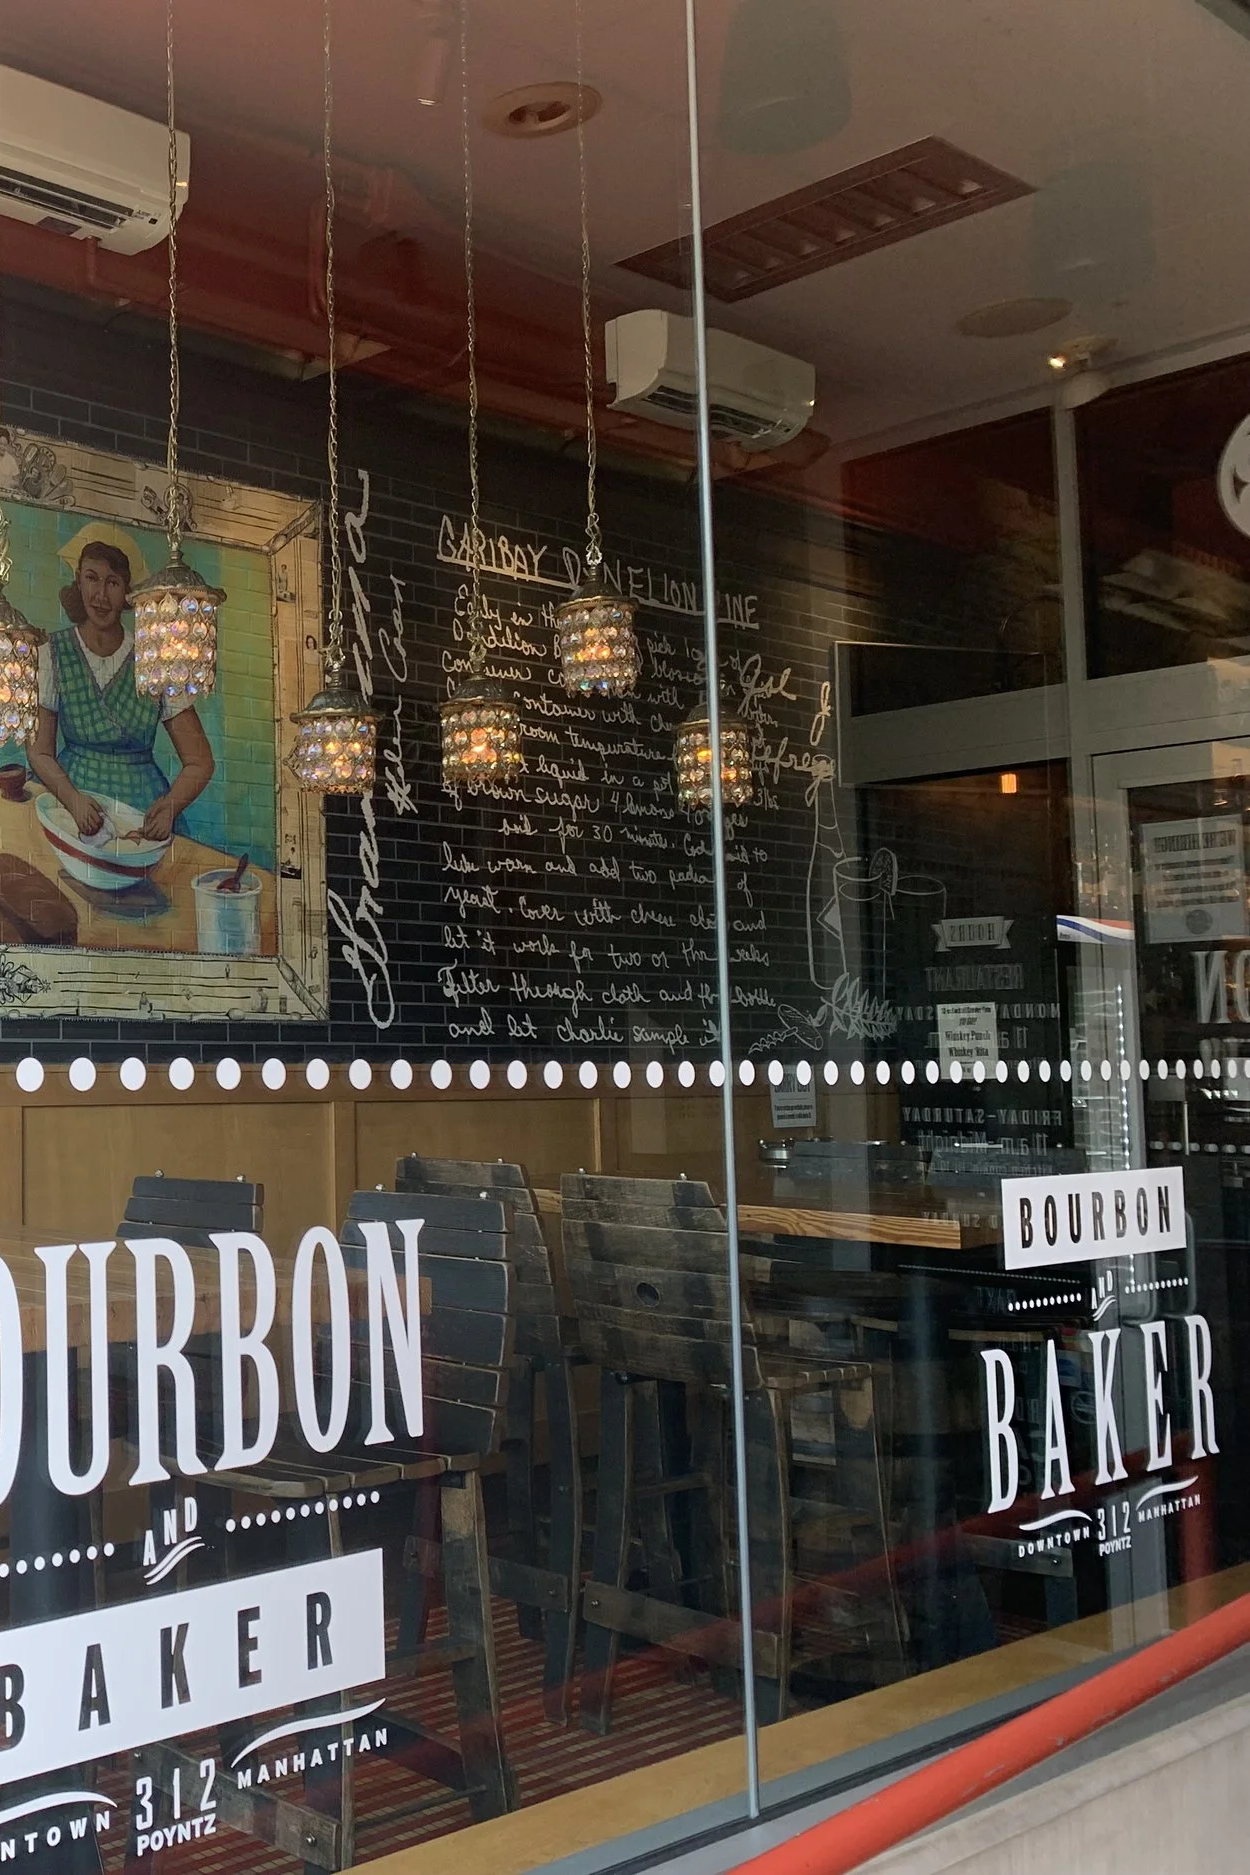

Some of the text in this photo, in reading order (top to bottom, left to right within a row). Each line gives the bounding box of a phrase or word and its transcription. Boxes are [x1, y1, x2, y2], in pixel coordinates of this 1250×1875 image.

[436, 513, 548, 581] GARIBAY
[535, 786, 600, 823] sugar
[549, 816, 584, 854] for
[592, 825, 612, 843] 30
[546, 855, 577, 877] and
[590, 855, 621, 883] add
[733, 910, 767, 932] and
[444, 925, 470, 949] let
[607, 943, 642, 970] two
[602, 983, 651, 1005] cloth
[658, 980, 693, 1001] and
[448, 1006, 496, 1039] and
[507, 1013, 538, 1039] let
[632, 1023, 690, 1055] sample
[1019, 1185, 1172, 1249] BOURBON
[1091, 1270, 1114, 1310] AND
[980, 1314, 1220, 1514] BAKER
[1137, 1494, 1201, 1523] MANHATTAN
[142, 1497, 199, 1566] AND
[1018, 1526, 1090, 1558] DOWNTOWN
[1099, 1536, 1132, 1557] POYNTZ
[237, 1727, 388, 1789] MANHATTAN
[135, 1757, 217, 1831] 312
[136, 1812, 217, 1856] POYNTZ
